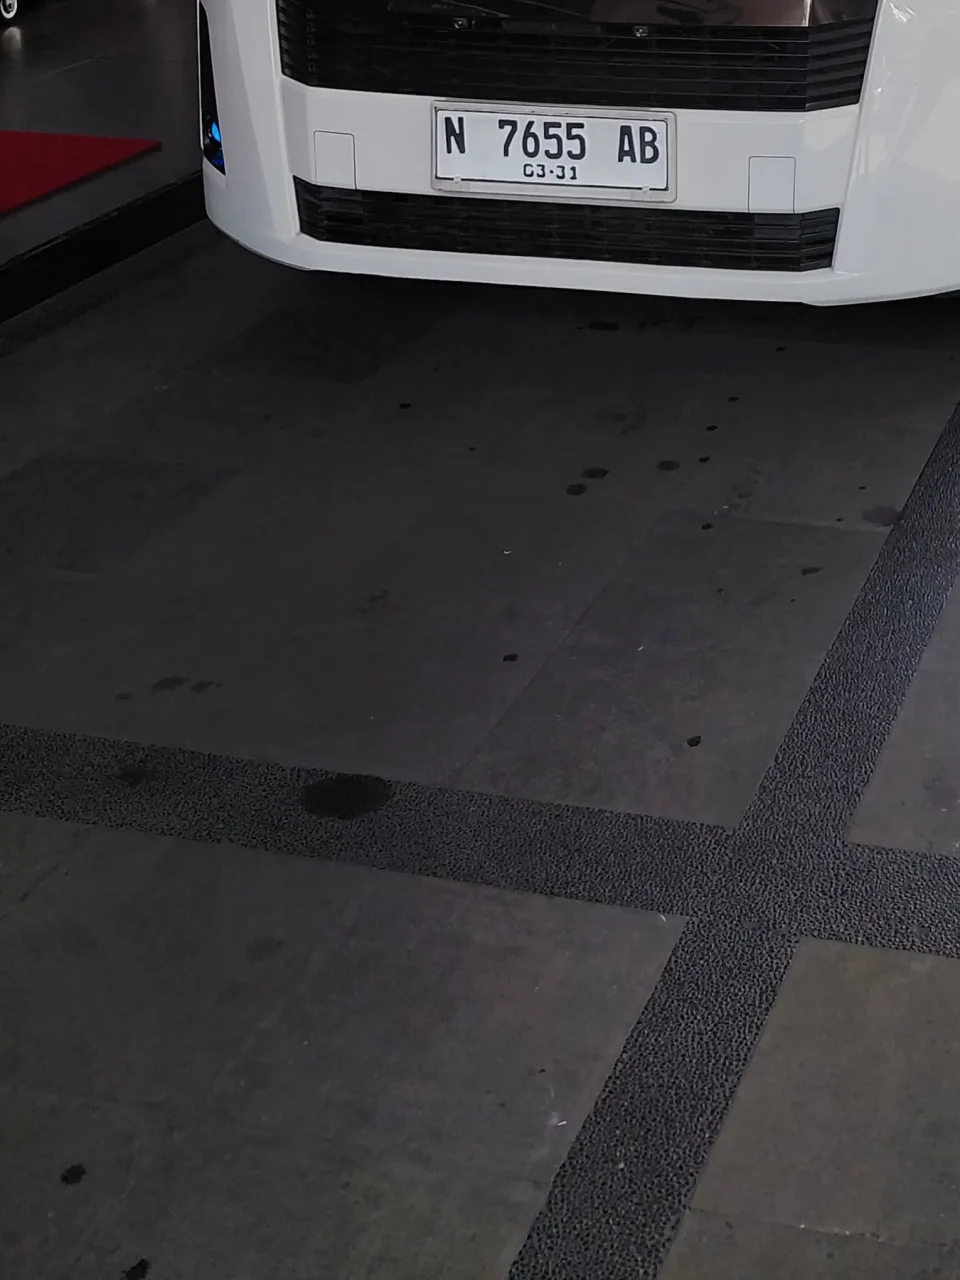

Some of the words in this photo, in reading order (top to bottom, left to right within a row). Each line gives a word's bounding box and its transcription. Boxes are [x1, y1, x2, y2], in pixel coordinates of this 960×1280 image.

[444, 116, 466, 154] N
[498, 119, 587, 160] 7655
[617, 125, 660, 164] AB
